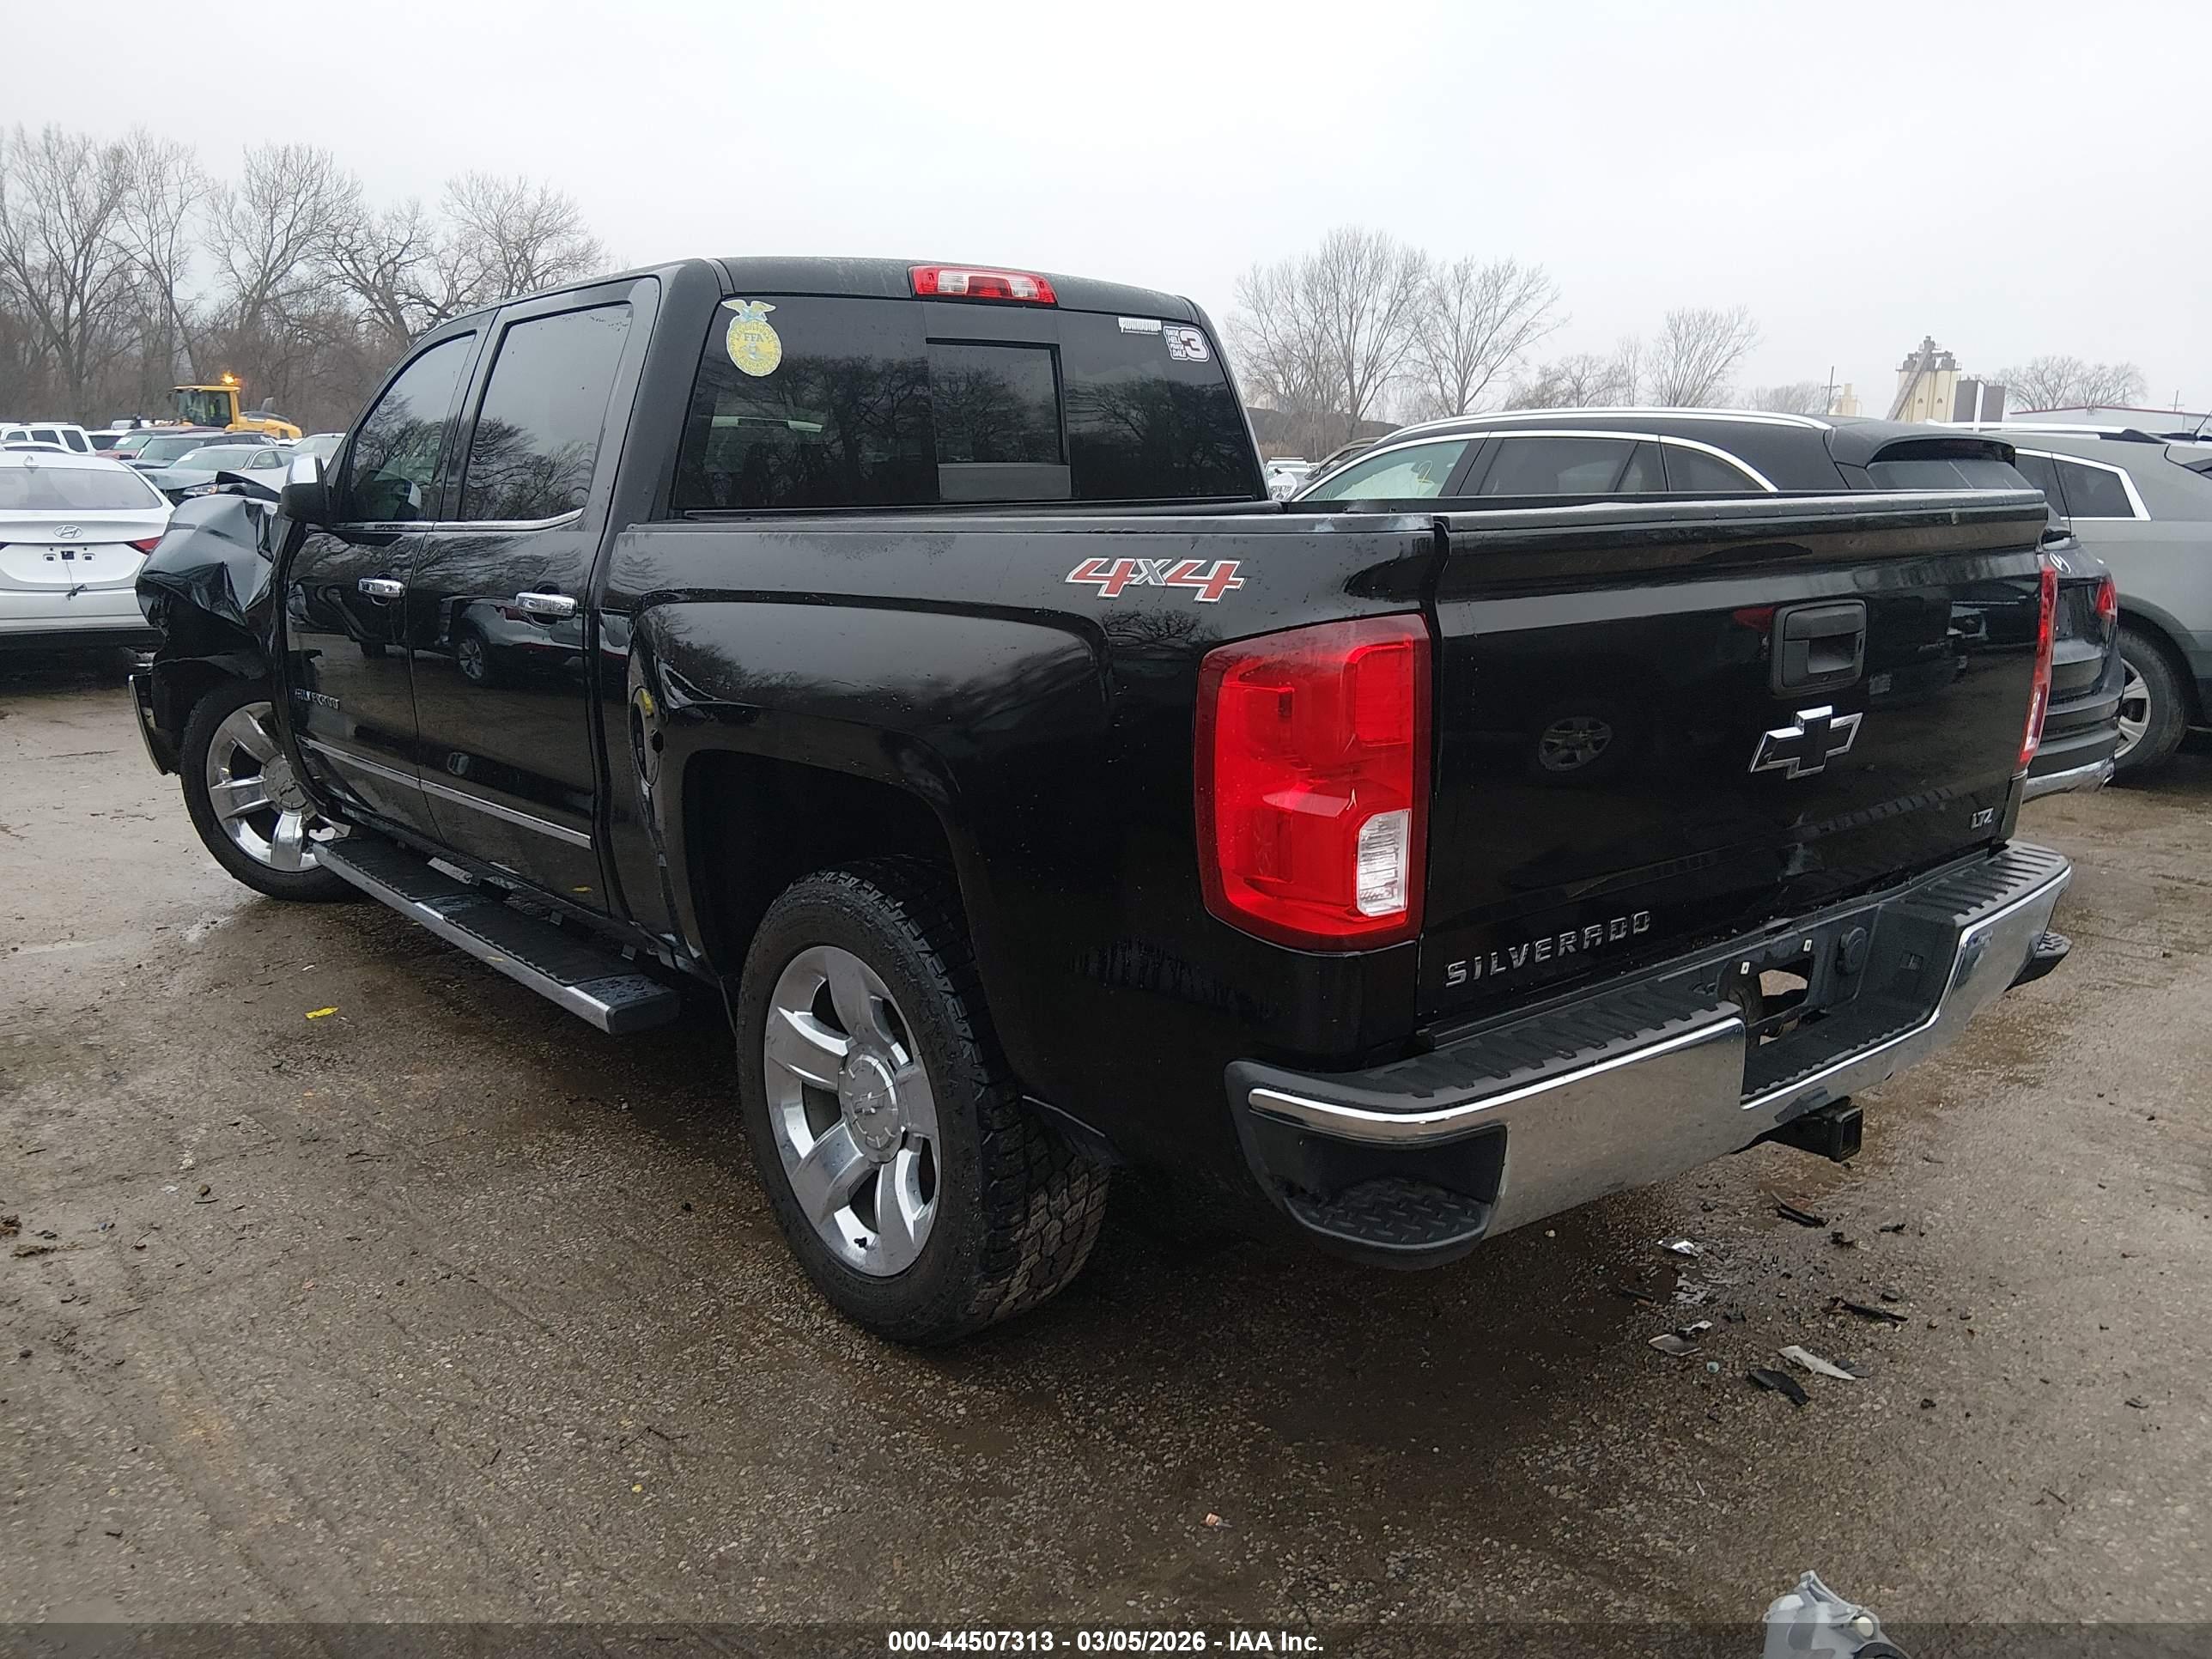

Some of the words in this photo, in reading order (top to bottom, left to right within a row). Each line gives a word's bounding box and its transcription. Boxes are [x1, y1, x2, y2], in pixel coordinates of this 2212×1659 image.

[744, 332, 764, 343] FFA
[1180, 330, 1207, 359] 3
[1971, 807, 1994, 830] LTZ
[1445, 910, 1650, 988] SILVERADO
